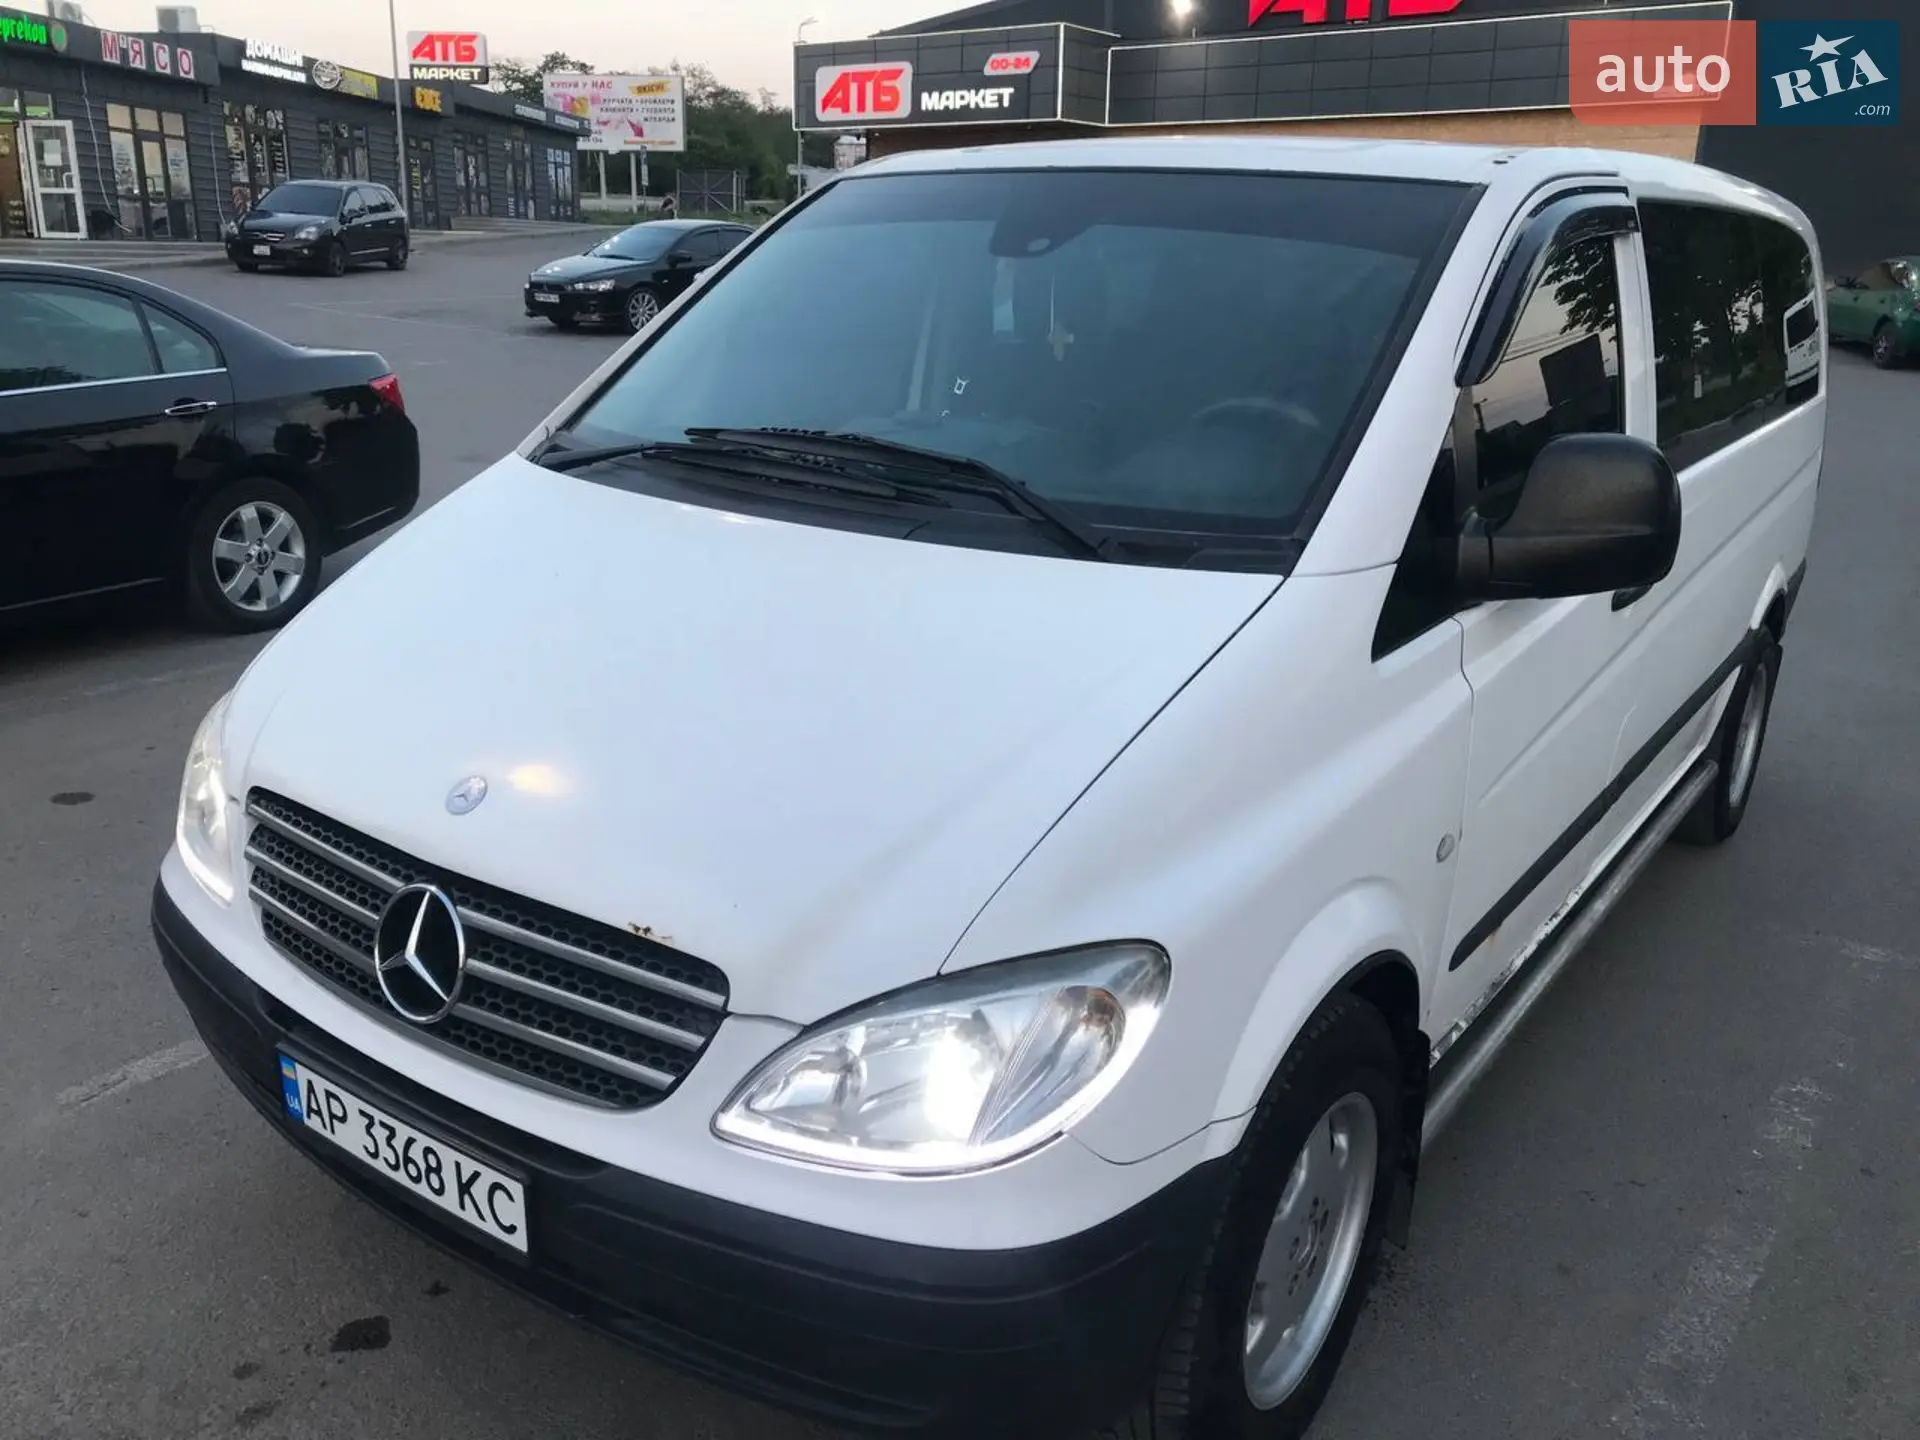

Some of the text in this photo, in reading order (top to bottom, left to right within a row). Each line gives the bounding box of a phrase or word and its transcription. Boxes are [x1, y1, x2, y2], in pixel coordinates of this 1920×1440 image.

[102, 32, 192, 76] М'ЯСО
[412, 34, 477, 62] АТБ
[412, 67, 481, 80] МАРКЕТ
[990, 56, 1031, 71] 00-24
[591, 80, 613, 90] НАС
[821, 68, 904, 114] АТБ
[921, 88, 1014, 111] МАРКЕТ
[286, 1093, 301, 1113] UA
[306, 1078, 518, 1235] AP 3368 KC
